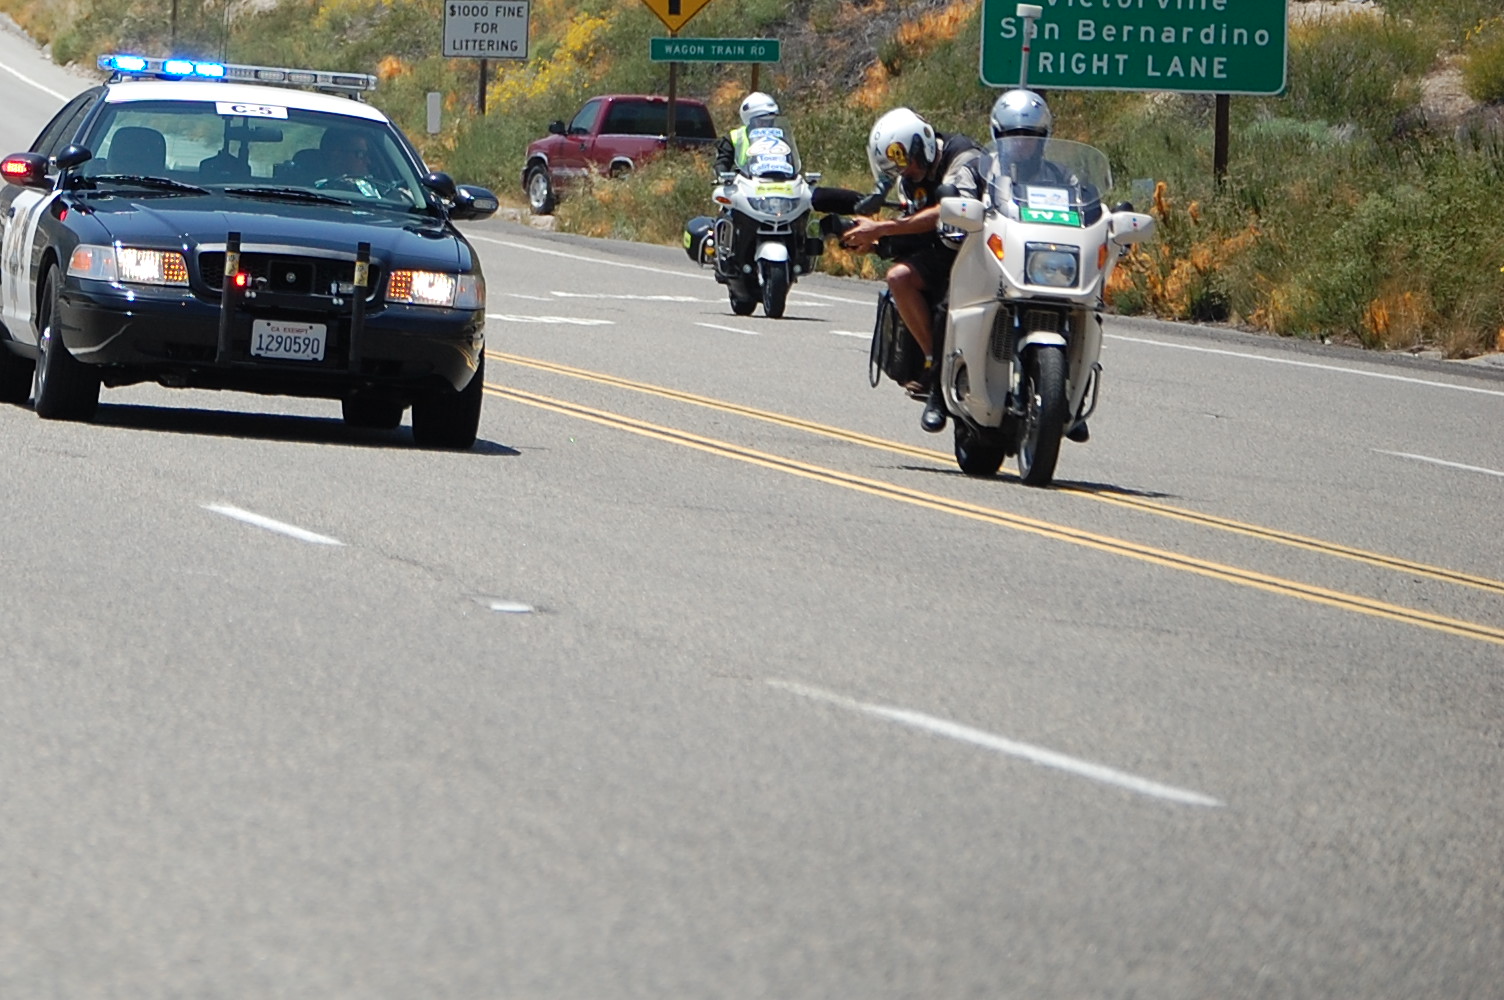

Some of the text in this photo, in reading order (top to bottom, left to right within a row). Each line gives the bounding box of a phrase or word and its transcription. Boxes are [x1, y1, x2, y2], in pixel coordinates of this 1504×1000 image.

[449, 5, 524, 17] $1000 FINE
[474, 23, 498, 34] FOR
[1078, 20, 1269, 46] Bernardino
[453, 40, 518, 52] LITTERING
[665, 45, 765, 56] WAGON TRAIN RD
[1039, 52, 1228, 78] RIGHT LANE
[1028, 210, 1069, 222] TV 1
[256, 333, 320, 354] 1290590
